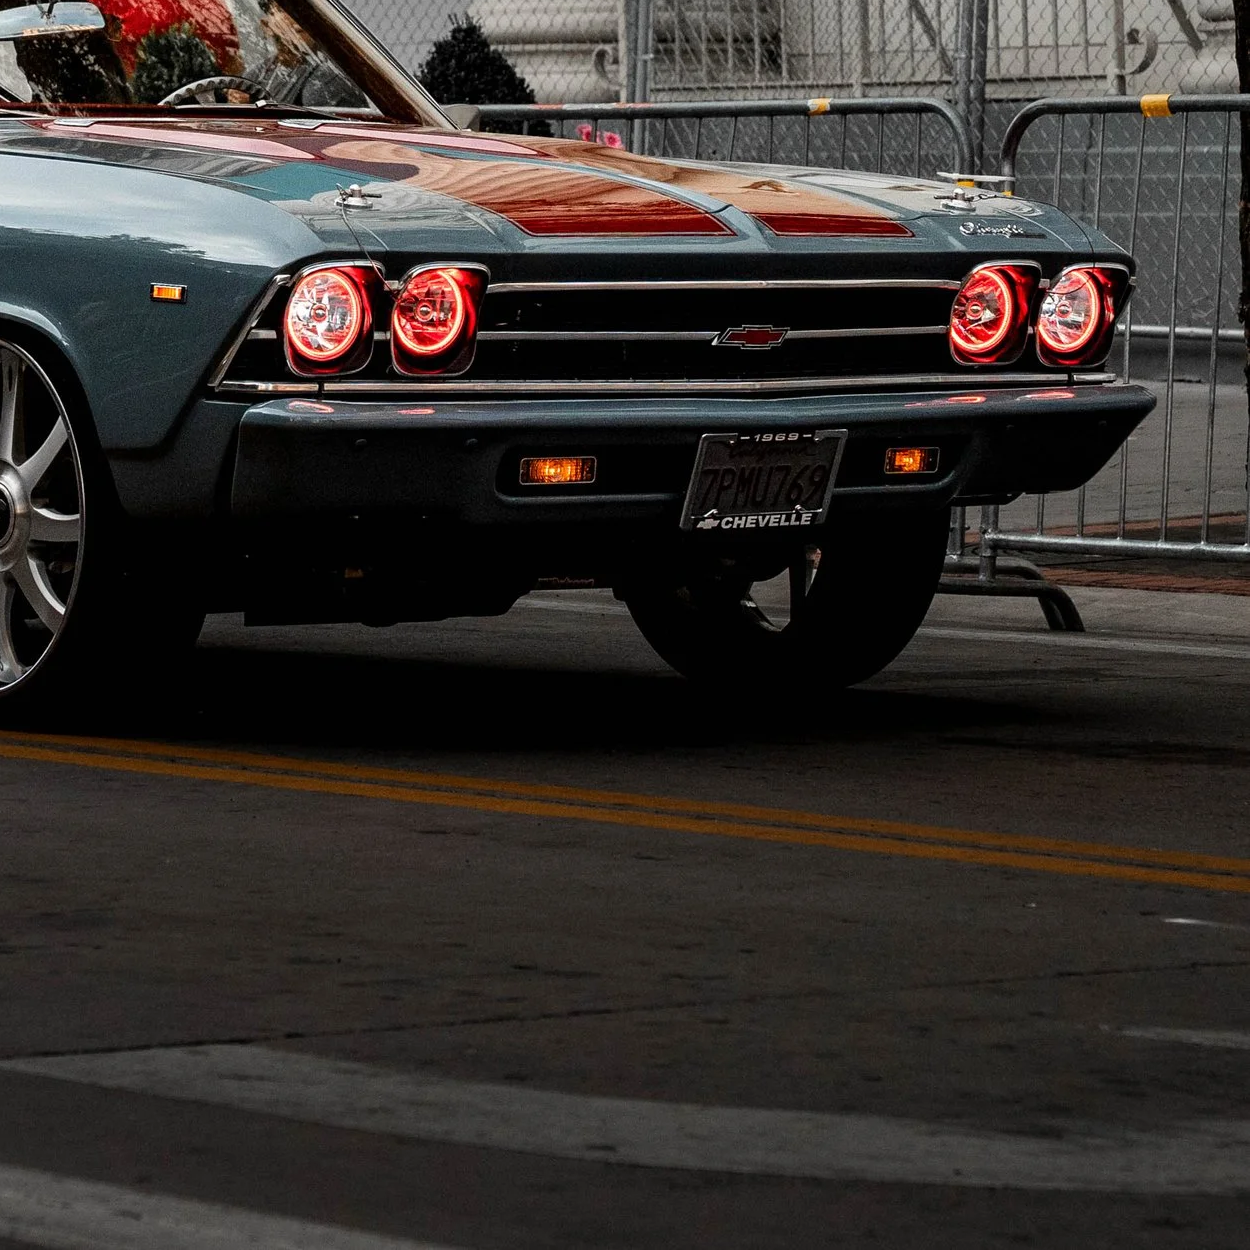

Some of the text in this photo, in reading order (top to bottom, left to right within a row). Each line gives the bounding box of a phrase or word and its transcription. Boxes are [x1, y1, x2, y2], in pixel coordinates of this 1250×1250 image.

[753, 432, 800, 442] 1969
[700, 464, 827, 509] 7PMU769
[720, 513, 813, 530] CHEVELLE
